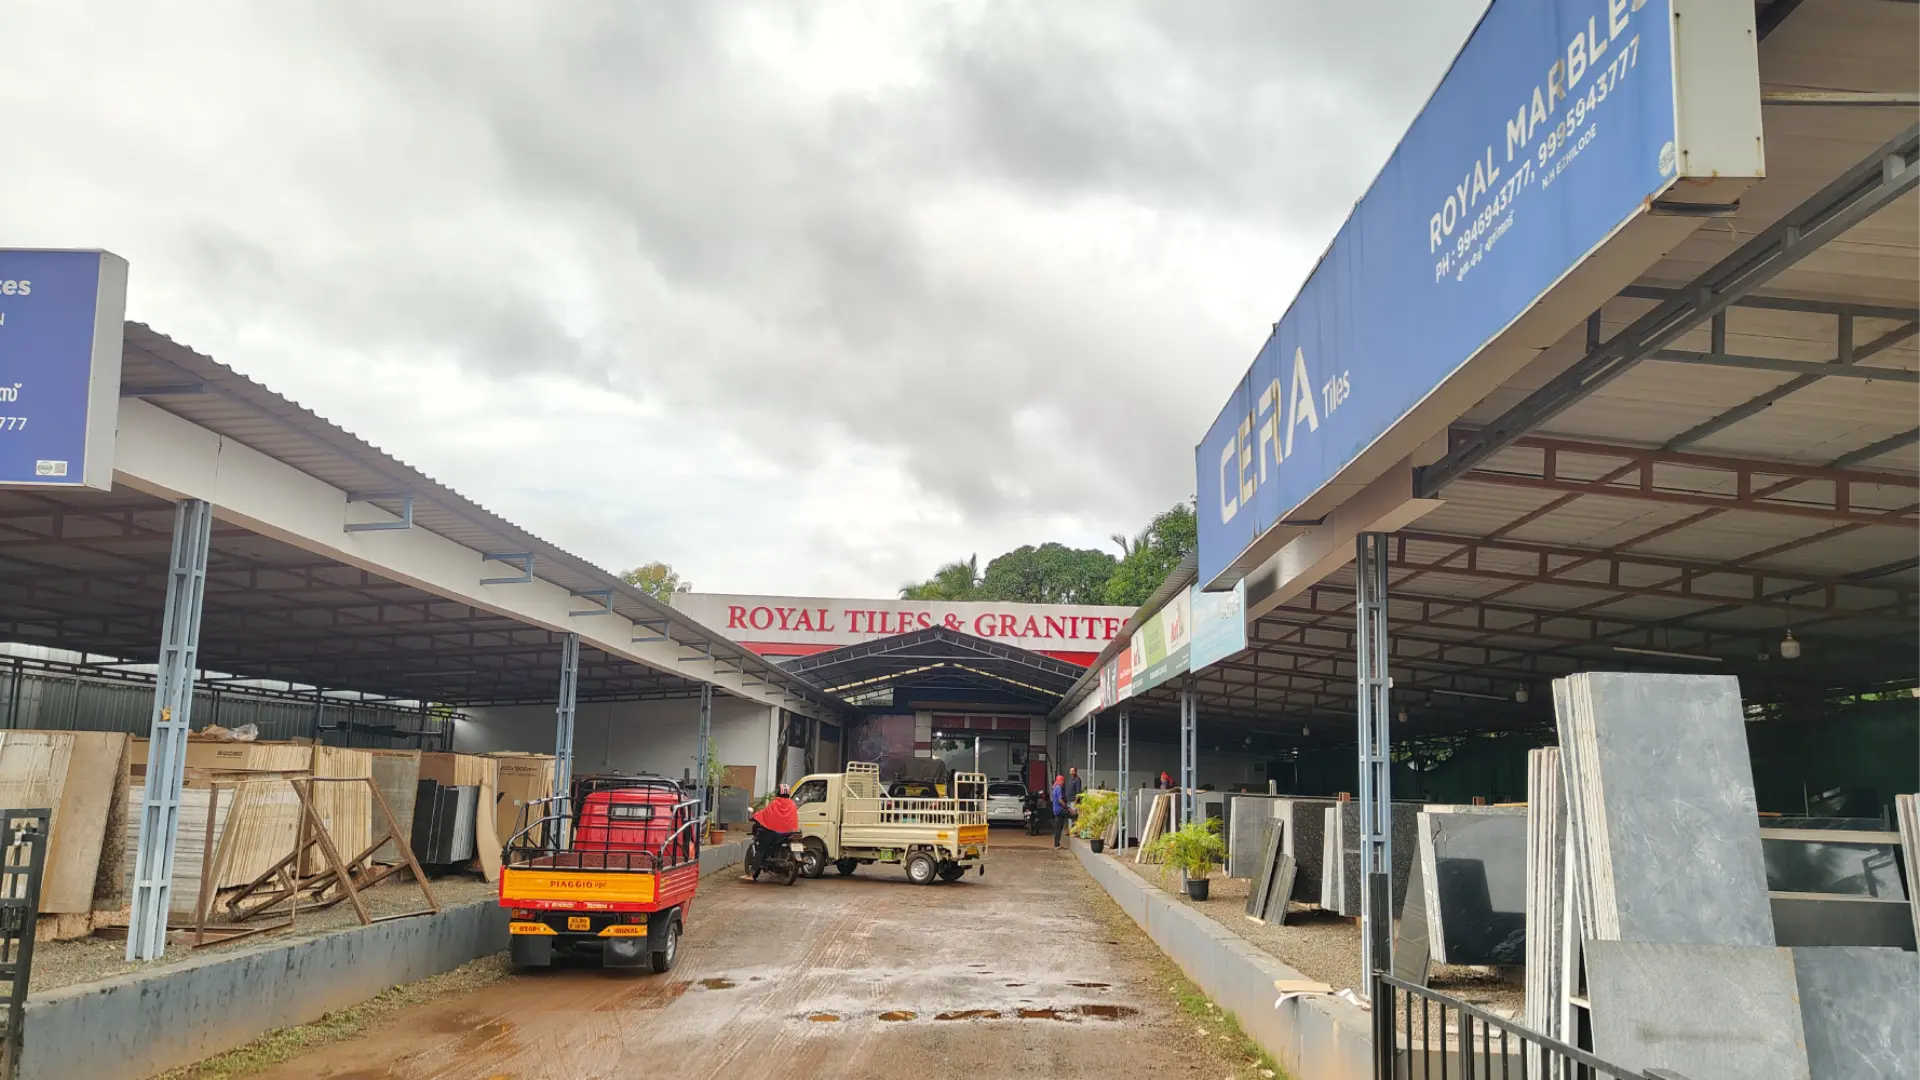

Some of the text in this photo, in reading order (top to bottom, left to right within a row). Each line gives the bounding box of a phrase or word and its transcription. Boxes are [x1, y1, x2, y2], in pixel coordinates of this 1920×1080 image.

[1430, 0, 1649, 254] ROYAL MARBLE
[1457, 159, 1536, 258] 9946943777,
[1538, 33, 1641, 168] 9995943777
[1556, 122, 1597, 176] EZHILODE
[1220, 346, 1350, 525] CERA Tiles
[727, 605, 1131, 641] ROYAL TILES & GRANITE
[550, 880, 593, 889] PIAGGIO
